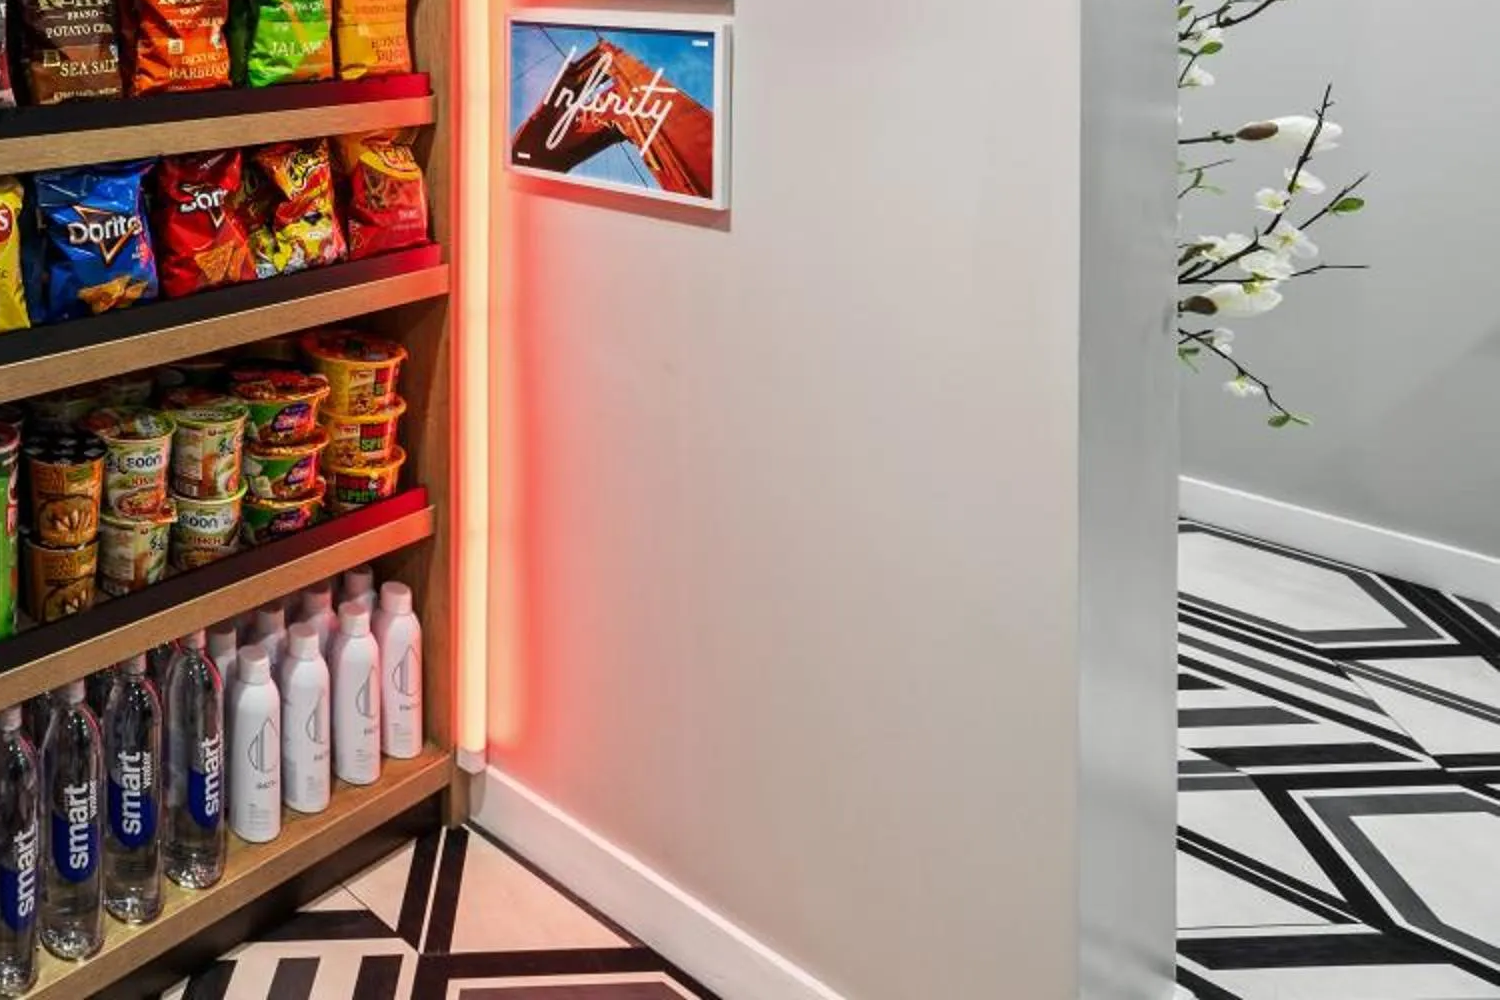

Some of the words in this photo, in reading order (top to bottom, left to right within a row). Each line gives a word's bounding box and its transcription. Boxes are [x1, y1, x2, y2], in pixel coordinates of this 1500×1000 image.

[60, 60, 90, 77] SEA
[544, 44, 679, 157] Infinity
[67, 214, 142, 245] Dorito
[118, 751, 141, 835] smart
[201, 733, 220, 817] smart
[64, 781, 89, 869] smart
[13, 825, 36, 917] smart
